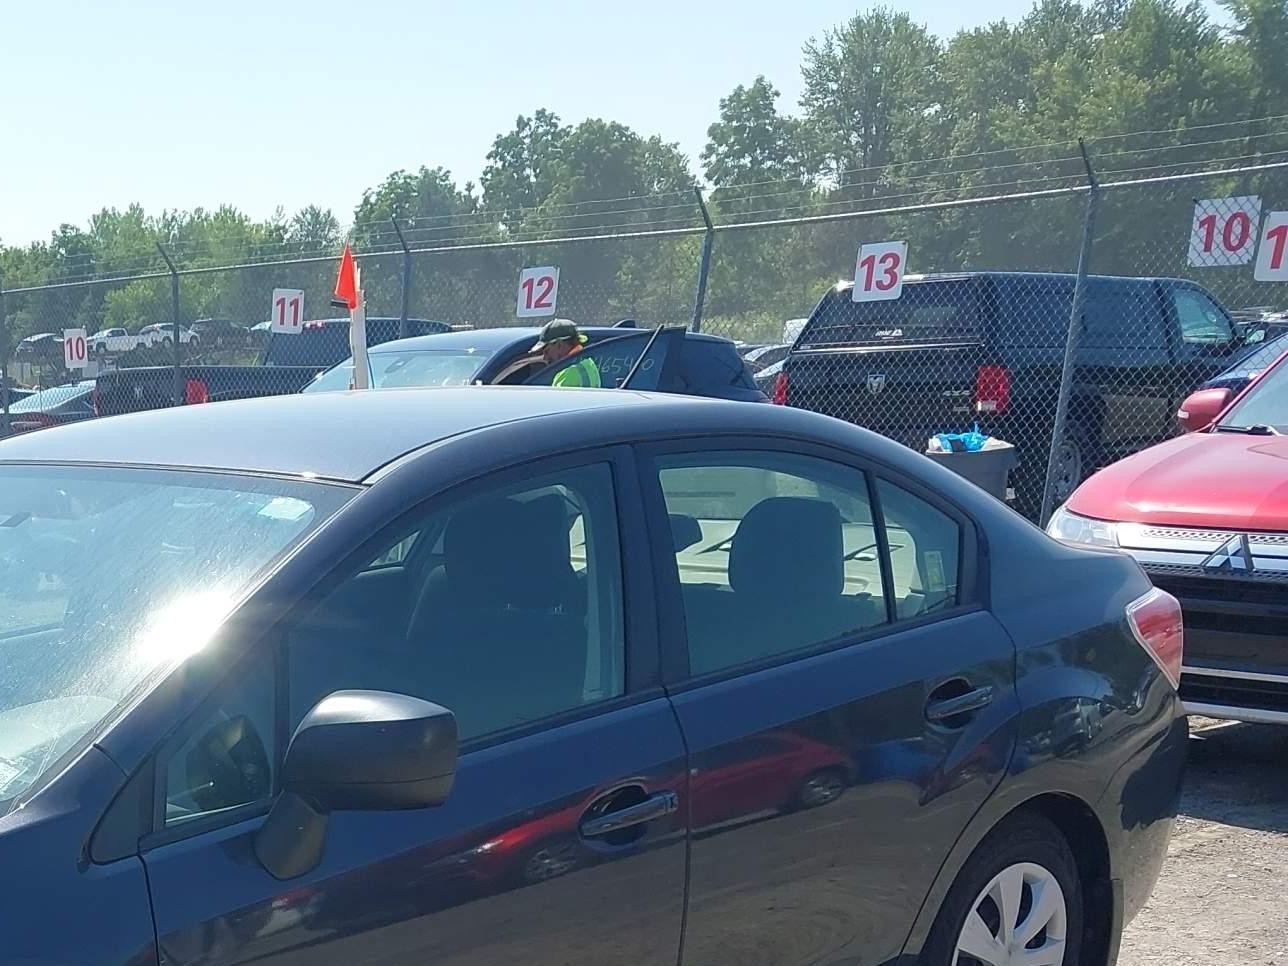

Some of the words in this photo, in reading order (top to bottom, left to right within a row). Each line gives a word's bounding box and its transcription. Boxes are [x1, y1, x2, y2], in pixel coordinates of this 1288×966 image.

[1198, 211, 1251, 253] 10
[1266, 225, 1288, 269] 1
[860, 252, 901, 292] 13
[275, 296, 300, 326] 11
[522, 275, 554, 310] 12
[65, 336, 86, 361] 10
